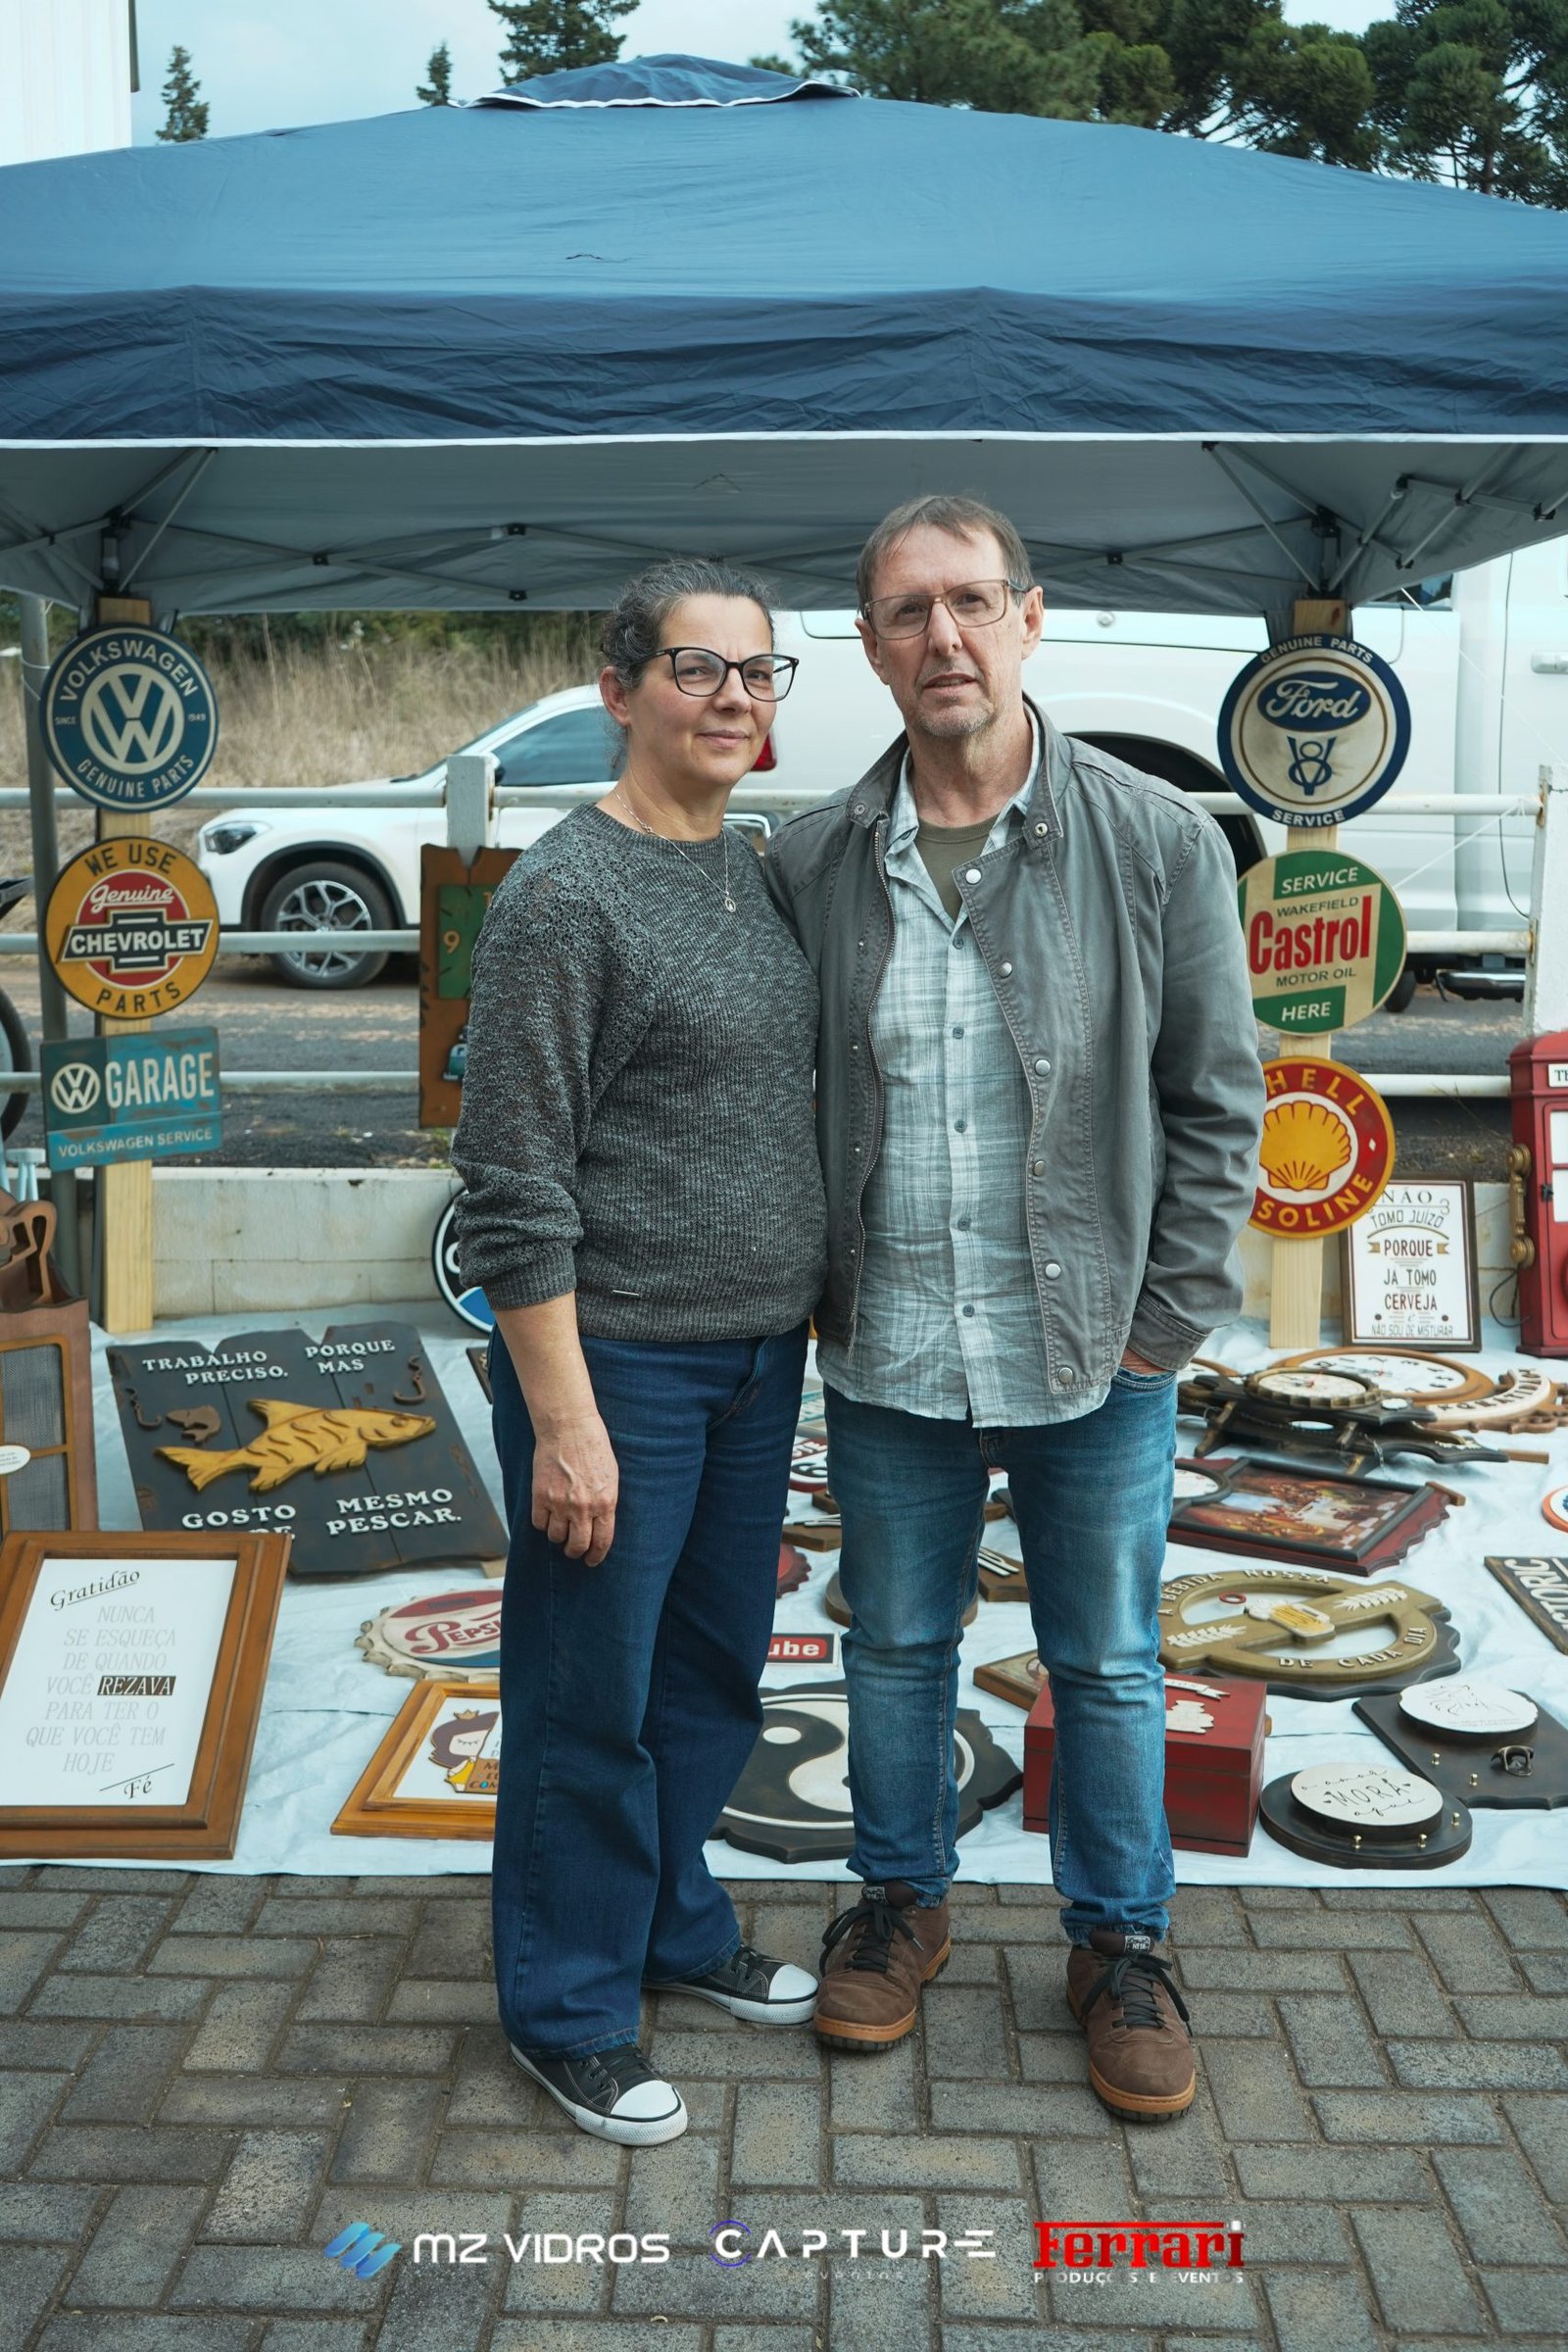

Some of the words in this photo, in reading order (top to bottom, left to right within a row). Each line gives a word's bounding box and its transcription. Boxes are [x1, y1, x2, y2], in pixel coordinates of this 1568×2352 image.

[1260, 635, 1323, 664] GENUINE
[1330, 637, 1374, 663] PARTS
[59, 639, 199, 702] VOLKSWAGEN
[1264, 678, 1361, 719] Ford
[77, 758, 145, 799] GENUINE
[152, 755, 195, 794] PARTS
[1272, 808, 1347, 828] SERVICE
[84, 847, 119, 877] WE
[128, 843, 177, 874] USE
[1281, 866, 1359, 895] SERVICE
[89, 884, 174, 914] Genuine
[1276, 896, 1359, 917] WAKEFIELD
[70, 927, 205, 956] CHEVROLET
[443, 930, 461, 954] 9
[1250, 895, 1372, 975] Castrol
[1276, 970, 1329, 988] MOTOR
[1333, 966, 1357, 979] OIL
[96, 980, 182, 1013] PARTS
[1281, 1001, 1332, 1022] HERE
[105, 1052, 215, 1109] GARAGE
[1266, 1068, 1365, 1116] HELL
[58, 1134, 154, 1158] VOLKSWAGEN
[157, 1128, 213, 1147] SERVICE
[1256, 1173, 1374, 1227] SOLINE
[1382, 1187, 1433, 1204] NÃO
[1370, 1209, 1404, 1228] TOMO
[1384, 1239, 1433, 1257] PORQUE
[1406, 1268, 1437, 1286] TOMO
[1384, 1294, 1438, 1310] CERVEJA
[142, 1350, 268, 1372] TRABALHO
[305, 1339, 396, 1359] PORQUE
[185, 1365, 289, 1386] PRECISO.
[318, 1358, 365, 1374] MAS
[181, 1504, 296, 1529] GOSTO
[336, 1488, 454, 1515] MESMO
[326, 1508, 462, 1537] PESCAR.
[50, 1569, 140, 1611] Gratidão
[1160, 1573, 1224, 1602] BEBIDA
[1243, 1569, 1331, 1585] NOSSA
[96, 1605, 156, 1624] NUNCA
[64, 1629, 88, 1646] SE
[96, 1629, 177, 1648] ESQUEÇA
[768, 1641, 820, 1656] ube
[1279, 1657, 1313, 1669] DE
[1338, 1648, 1403, 1668] CADA
[1403, 1627, 1428, 1646] DIA
[63, 1652, 88, 1670] DE
[94, 1652, 167, 1672] QUANDO
[46, 1674, 94, 1695] VOCÊ
[98, 1676, 174, 1695] REZAVA
[44, 1701, 94, 1720] PARA
[103, 1701, 139, 1720] TER
[146, 1702, 159, 1719] O
[25, 1727, 65, 1747] QUE
[72, 1724, 122, 1746] VOCÊ
[129, 1727, 167, 1746] TEM
[62, 1752, 116, 1775] HOJE
[123, 1775, 153, 1799] Fé
[1325, 1778, 1410, 1807] MORA
